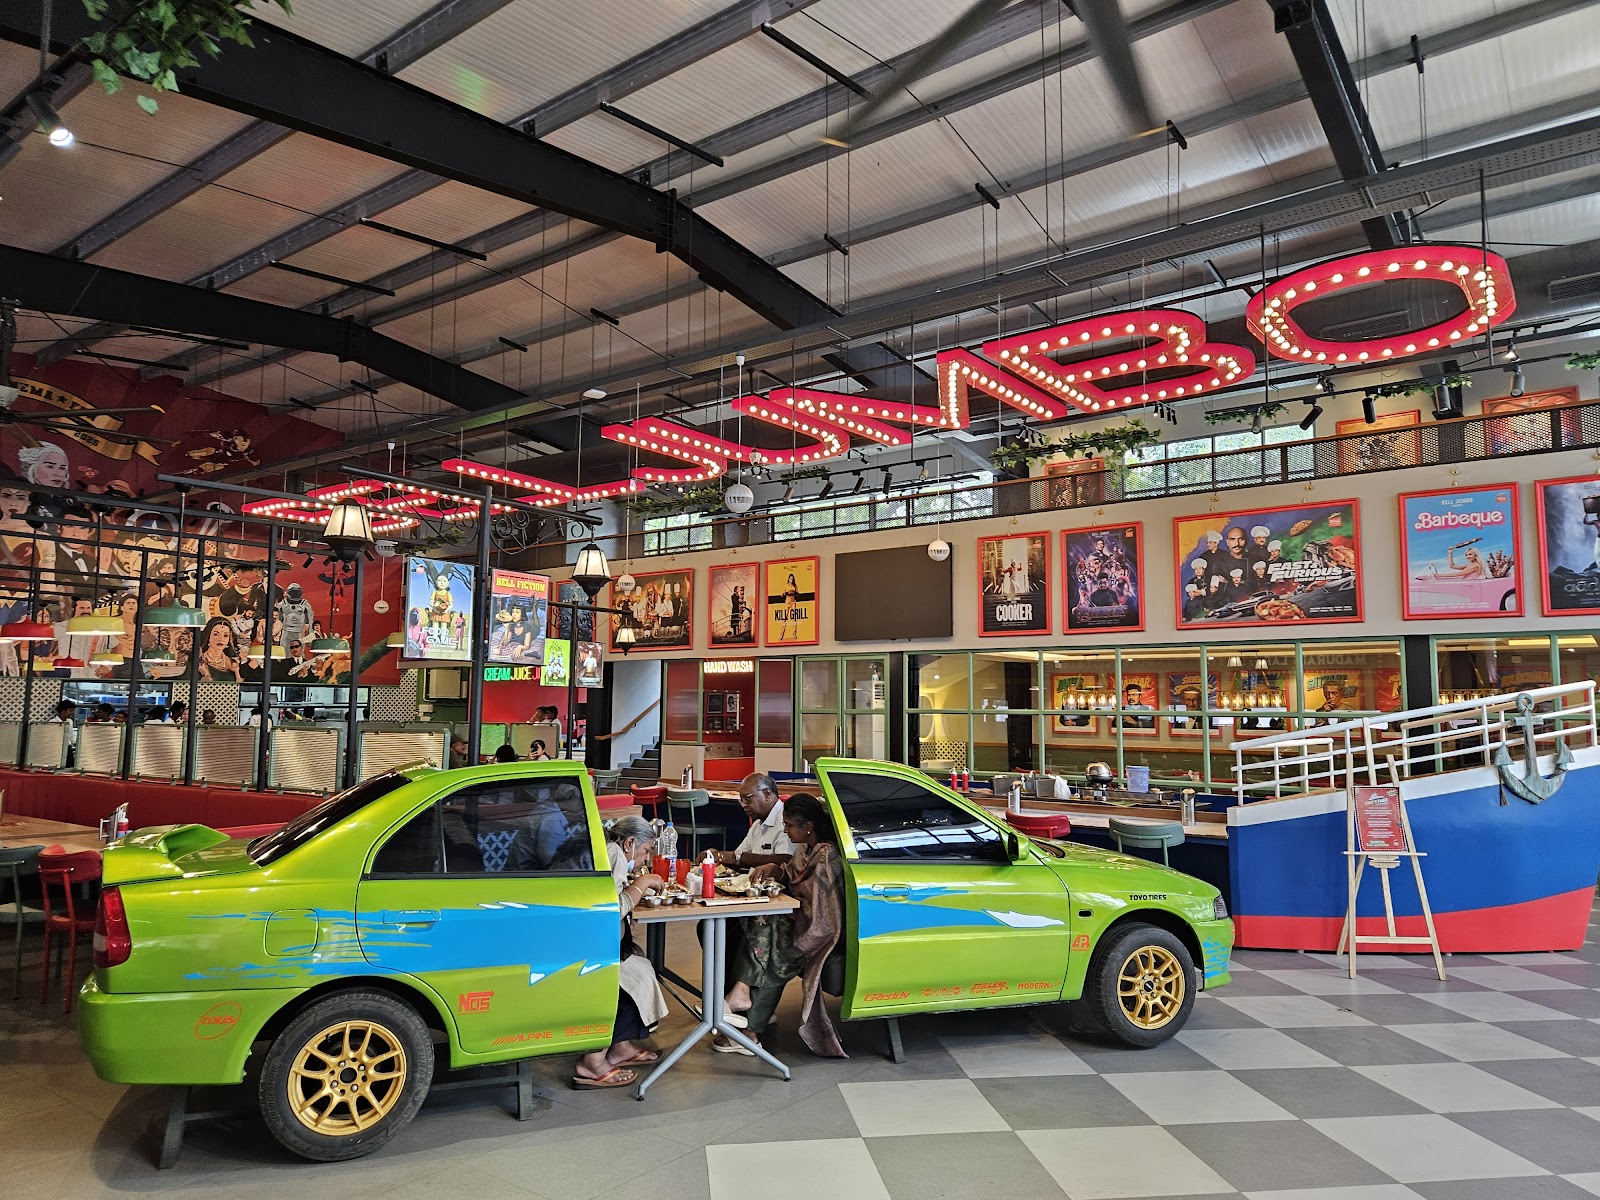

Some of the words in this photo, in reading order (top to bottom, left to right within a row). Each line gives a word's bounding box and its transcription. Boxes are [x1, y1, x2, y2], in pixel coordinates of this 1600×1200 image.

[600, 244, 1517, 484] JUMBO
[1414, 510, 1504, 529] Barbeque
[1267, 560, 1312, 574] FAST
[1270, 567, 1342, 582] FURIOUS
[496, 577, 515, 588] BELL
[517, 580, 546, 592] FICTION
[774, 609, 788, 621] KILL
[789, 607, 808, 621] GRILL
[995, 603, 1033, 621] COOKER
[426, 636, 459, 648] GAME
[484, 667, 511, 681] CREAM
[510, 665, 532, 680] JUICE
[703, 660, 727, 673] HAND
[727, 660, 754, 673] WASH
[1018, 982, 1050, 990] MODERN
[458, 990, 494, 1012] NOS
[564, 1024, 610, 1036] sparco
[504, 1032, 553, 1043] ALPINE
